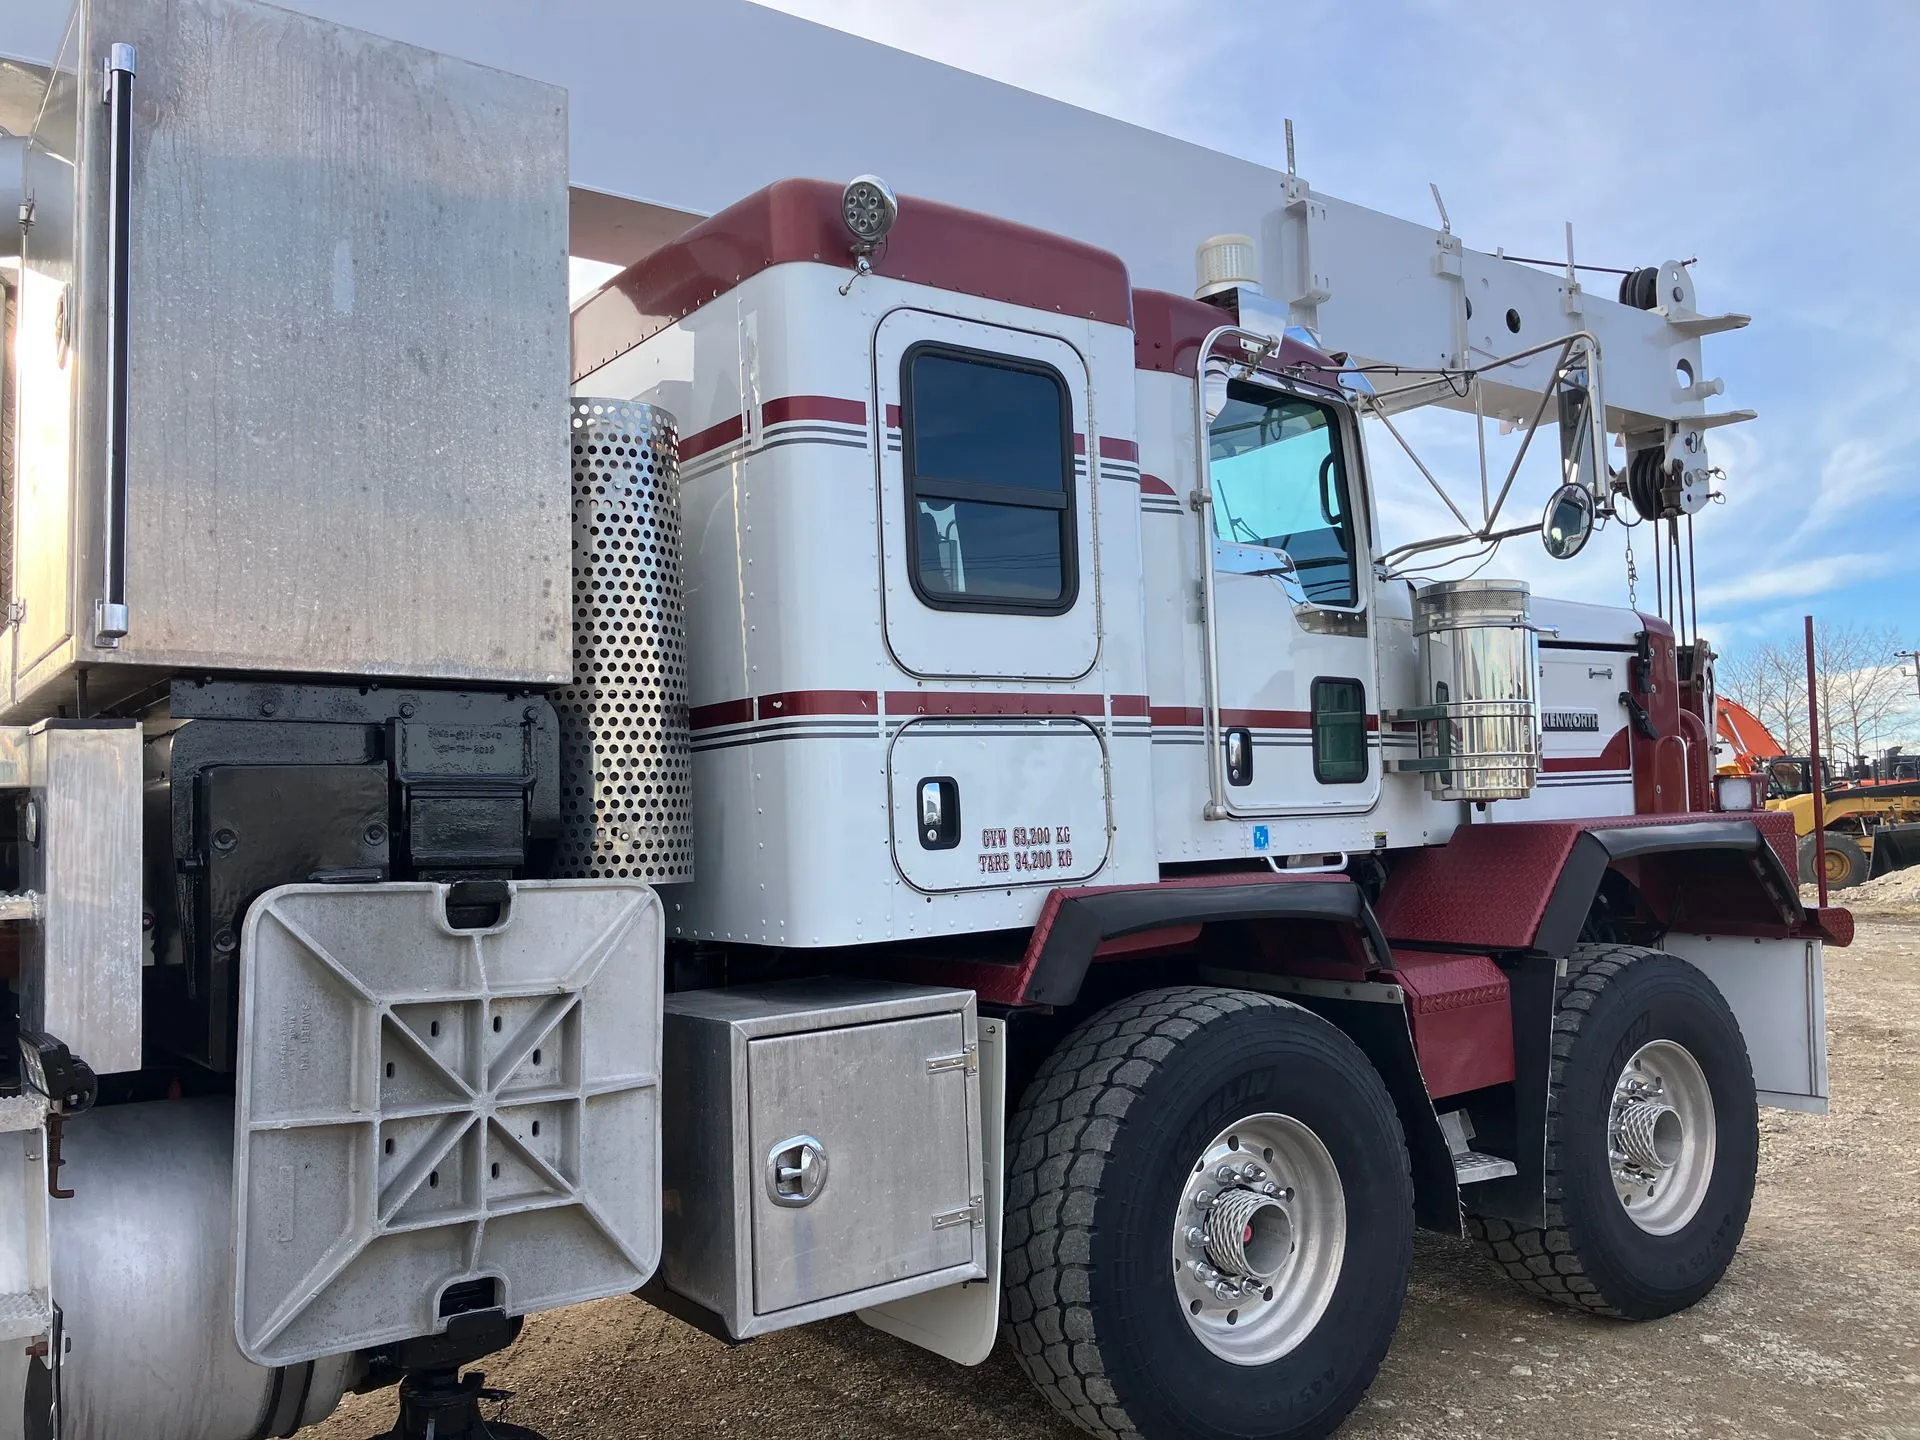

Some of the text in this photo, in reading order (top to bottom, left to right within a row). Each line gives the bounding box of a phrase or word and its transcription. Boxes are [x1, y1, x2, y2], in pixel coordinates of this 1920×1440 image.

[1541, 713, 1598, 729] KENWORTH
[983, 826, 1070, 848] GVW 63,200 KG
[978, 848, 1072, 873] TARE 34,200 KG
